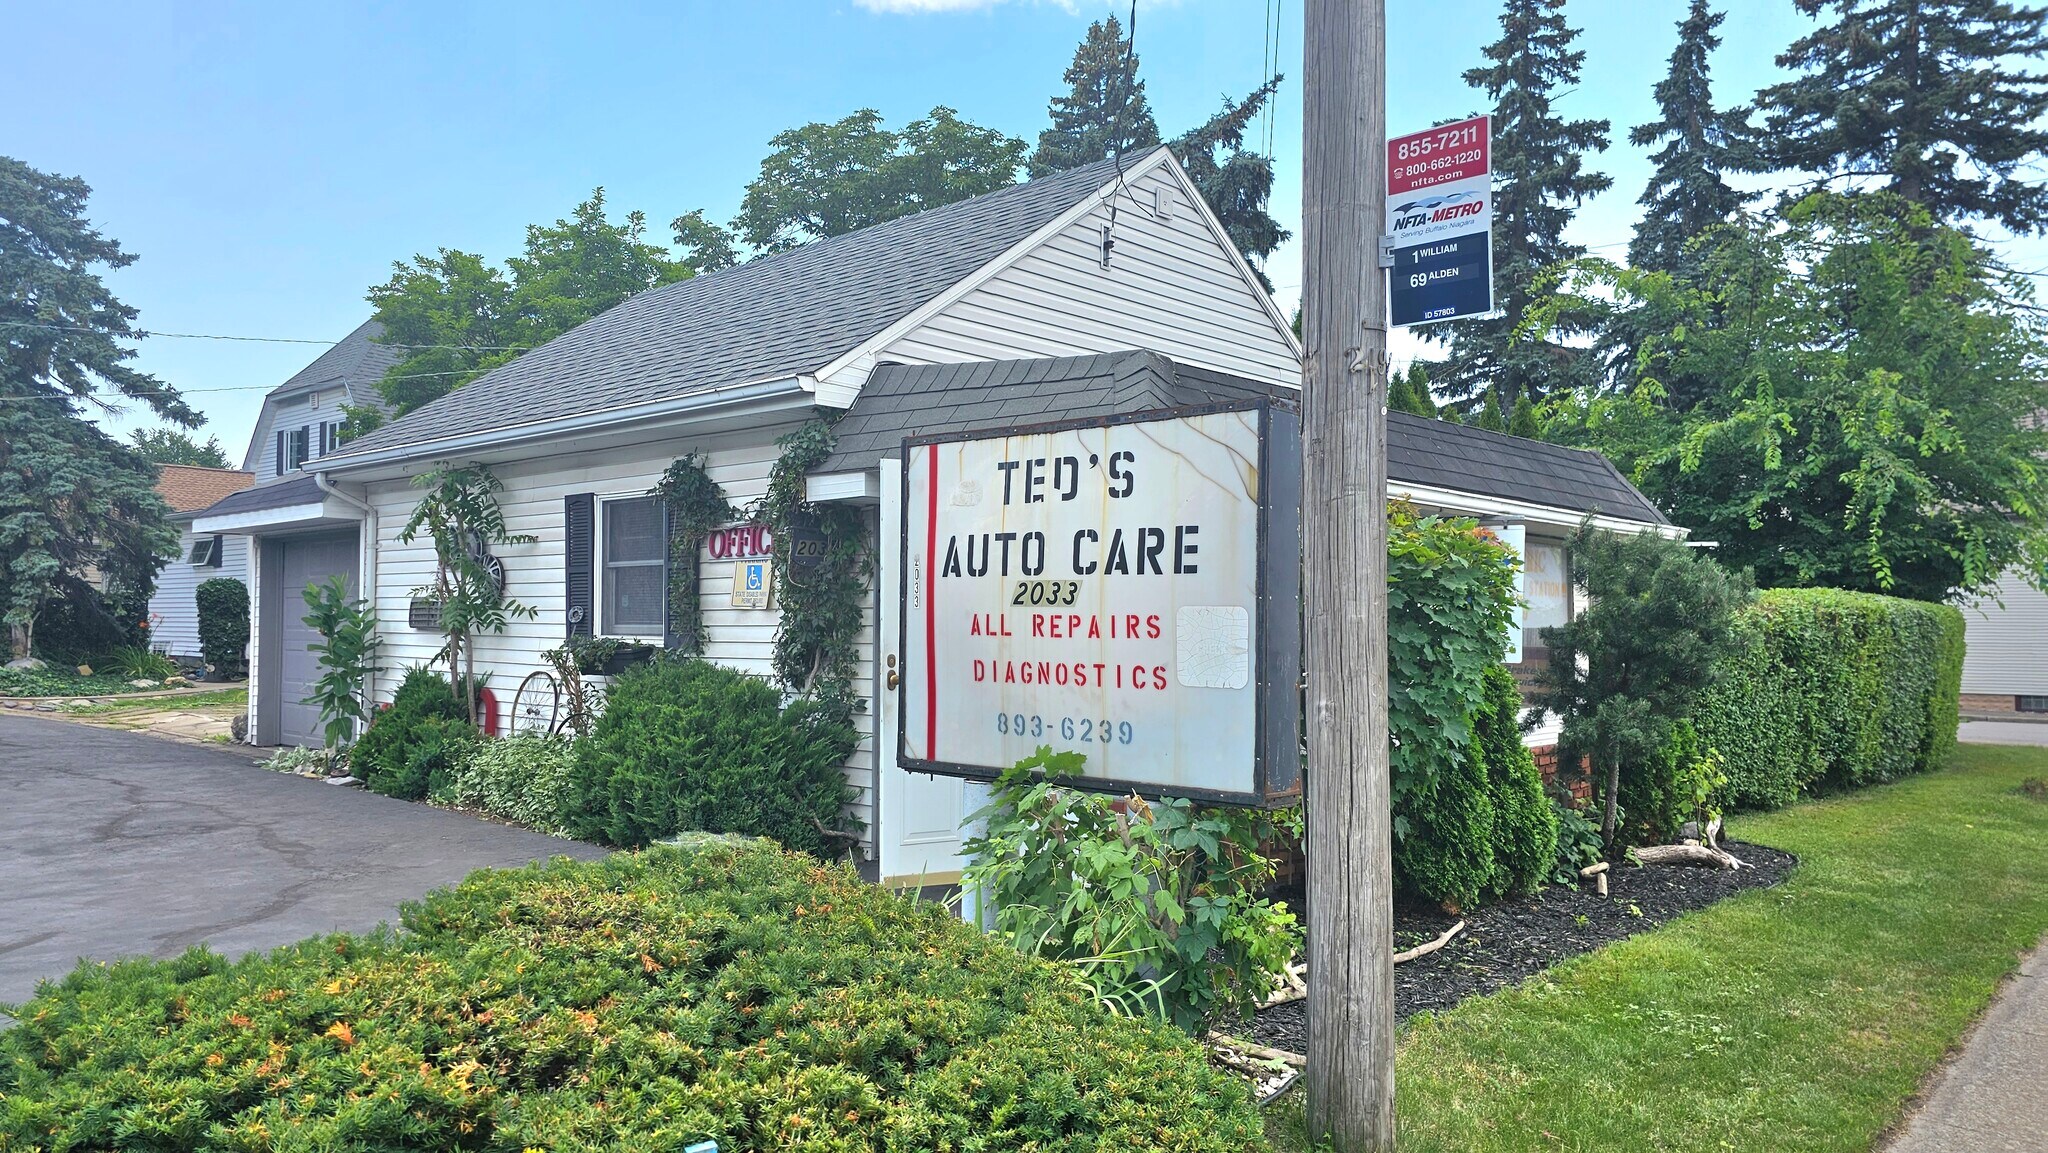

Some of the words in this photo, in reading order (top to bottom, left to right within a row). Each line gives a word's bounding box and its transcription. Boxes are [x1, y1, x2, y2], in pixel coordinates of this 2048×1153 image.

[1398, 125, 1477, 160] 855-7211
[1406, 149, 1481, 176] 800-662-1220
[1411, 170, 1463, 187] nfta.com
[1393, 201, 1483, 231] NFTA-METRO
[1400, 229, 1423, 239] Serving
[1425, 224, 1448, 234] Buffalo
[1449, 219, 1475, 229] Niagara
[1412, 250, 1419, 263] 1
[1420, 243, 1458, 257] WILLIAM
[1410, 272, 1427, 288] 69
[1428, 267, 1459, 280] ALDEN
[1425, 310, 1432, 319] ID
[1433, 307, 1455, 317] 57803
[997, 451, 1135, 506] TED'S
[708, 526, 774, 559] OFFIC
[942, 531, 1045, 578] AUTO
[1072, 526, 1199, 576] CARE
[1012, 581, 1079, 606] 2033
[971, 614, 1012, 637] ALL
[1032, 614, 1161, 639] REPAIRS
[973, 660, 1167, 690] DIAGNOSTICS
[997, 712, 1134, 745] 893-6239
